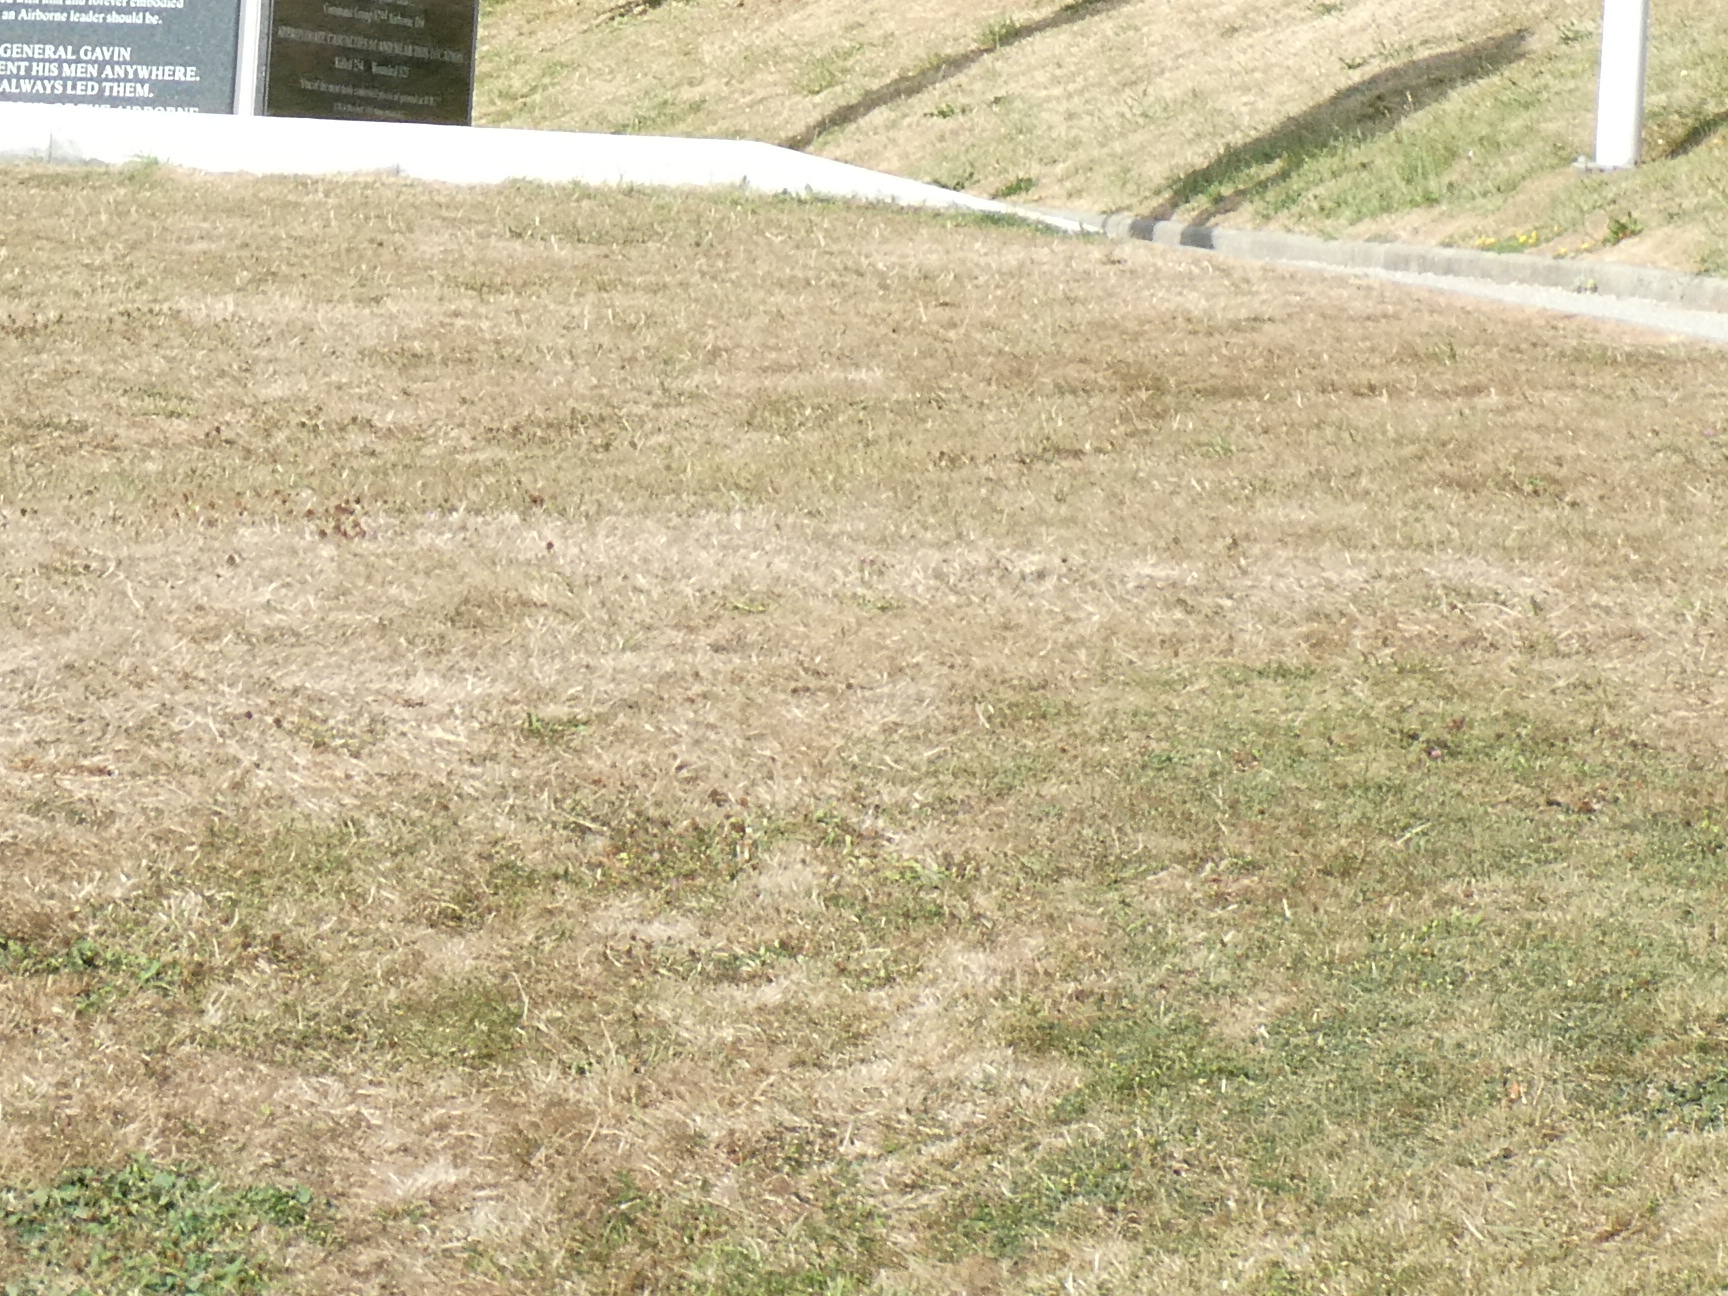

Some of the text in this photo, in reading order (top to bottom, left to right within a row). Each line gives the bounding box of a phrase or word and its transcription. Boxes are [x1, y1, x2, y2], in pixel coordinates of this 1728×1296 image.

[1, 10, 15, 20] an
[18, 8, 67, 21] Airborne
[70, 9, 103, 23] leader
[106, 10, 142, 24] should
[0, 42, 131, 62] GENERAL GAVIN
[31, 61, 58, 77] HIS
[62, 62, 98, 78] MEN
[66, 80, 98, 96] LED
[101, 81, 153, 98] THEM.
